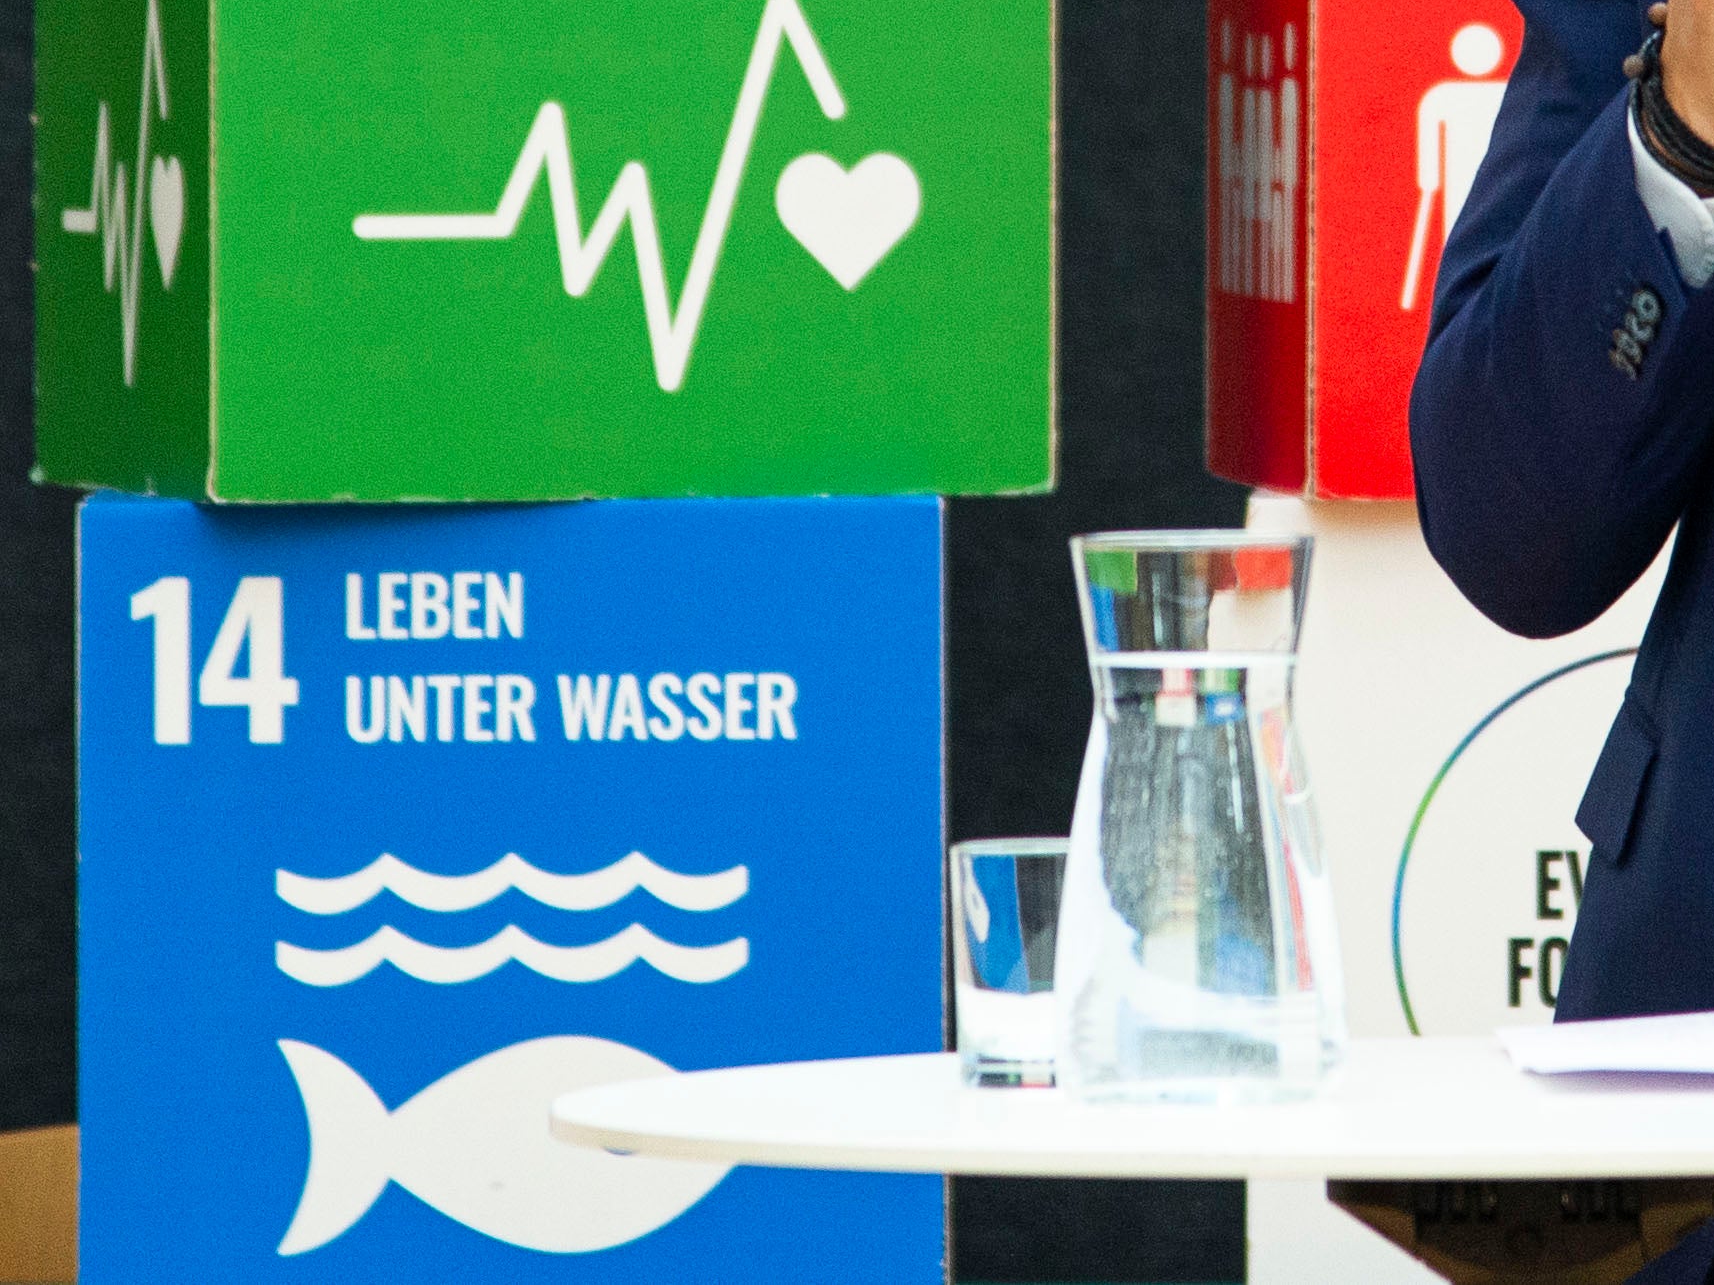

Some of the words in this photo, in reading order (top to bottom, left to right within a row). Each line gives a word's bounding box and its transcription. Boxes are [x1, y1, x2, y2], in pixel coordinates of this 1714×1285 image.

[346, 571, 524, 640] LEBEN
[131, 575, 300, 745] 14
[346, 674, 537, 744] UNTER
[557, 672, 799, 742] WASSER
